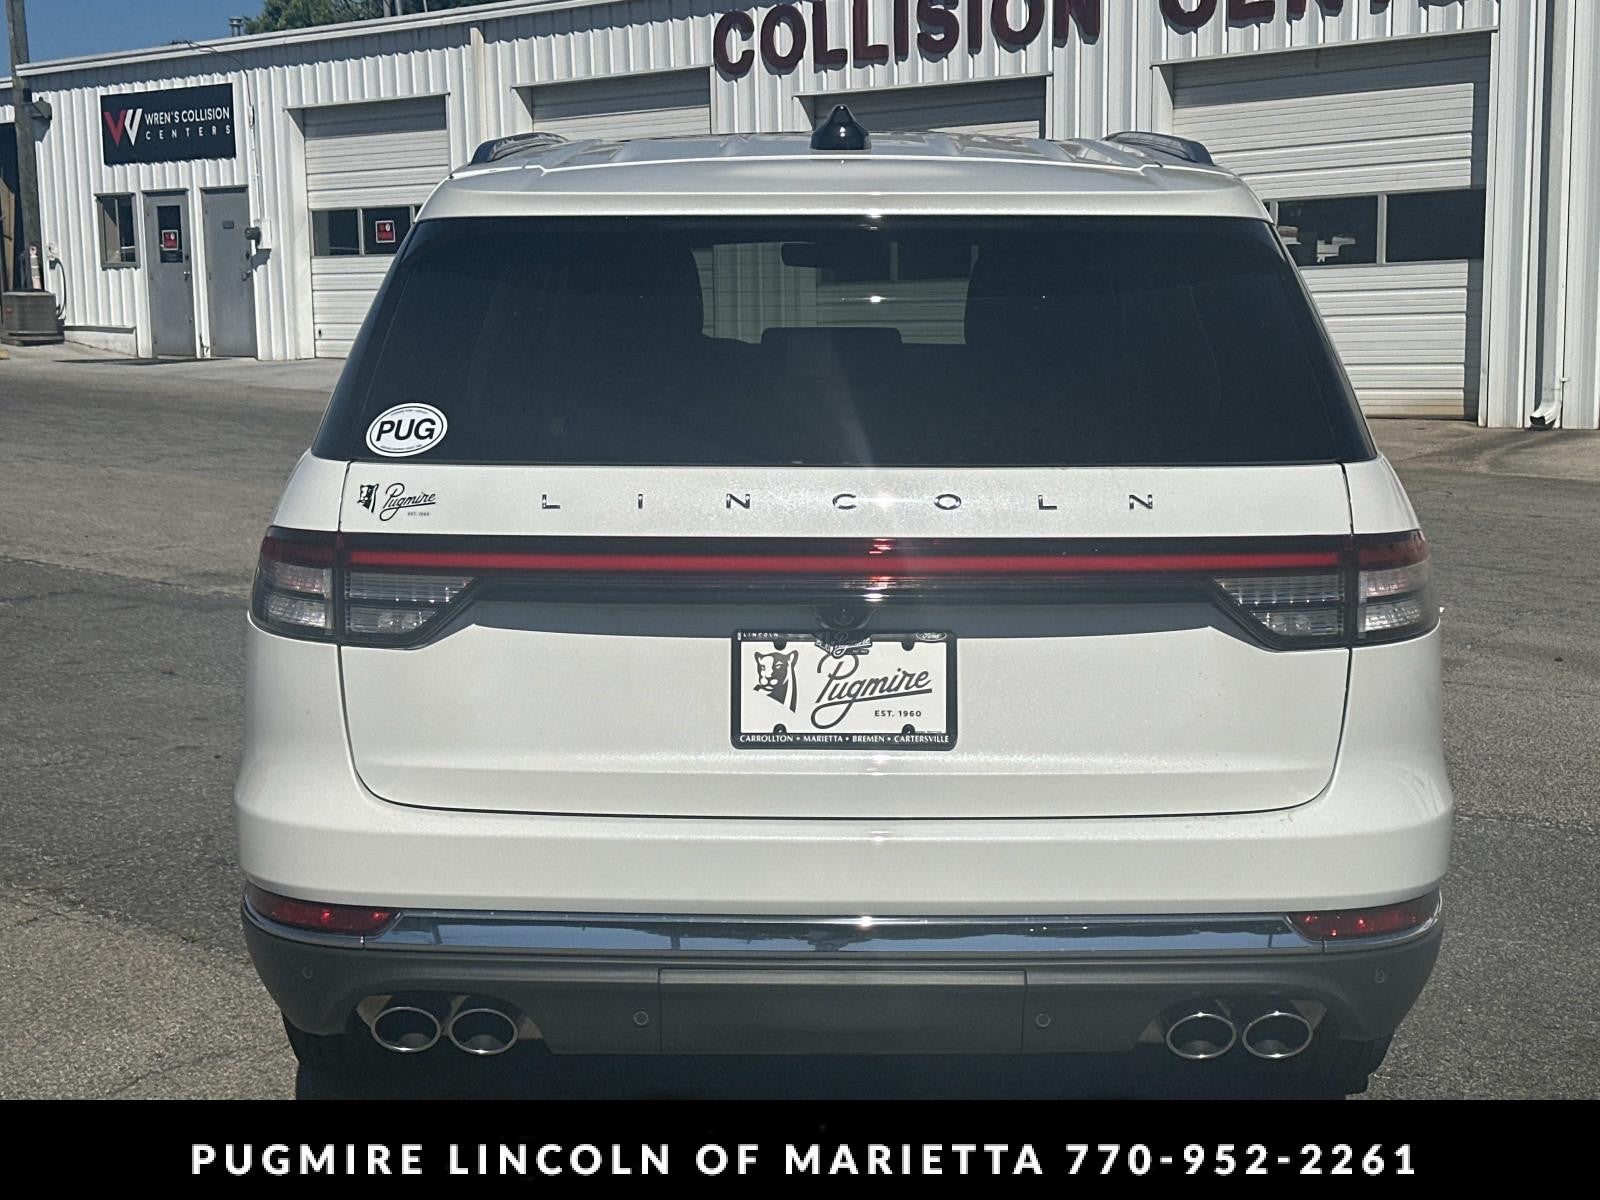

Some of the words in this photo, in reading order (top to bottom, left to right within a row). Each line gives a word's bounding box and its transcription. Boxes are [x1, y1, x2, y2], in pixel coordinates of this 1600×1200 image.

[713, 0, 1100, 76] COLLISION
[145, 110, 180, 125] WREN'S
[181, 107, 230, 122] COLLISION
[145, 125, 231, 140] CENTERS
[376, 418, 437, 442] PUG
[380, 482, 436, 522] Pugmire
[541, 493, 1154, 511] LINCOLN
[811, 653, 933, 729] Pugmire
[874, 709, 895, 717] EST.
[899, 709, 922, 717] 1960
[739, 734, 794, 743] CARROLLTON
[803, 734, 843, 743] MARIETTA
[852, 734, 885, 743] BREMEN
[894, 734, 950, 743] CARTERSVILLE
